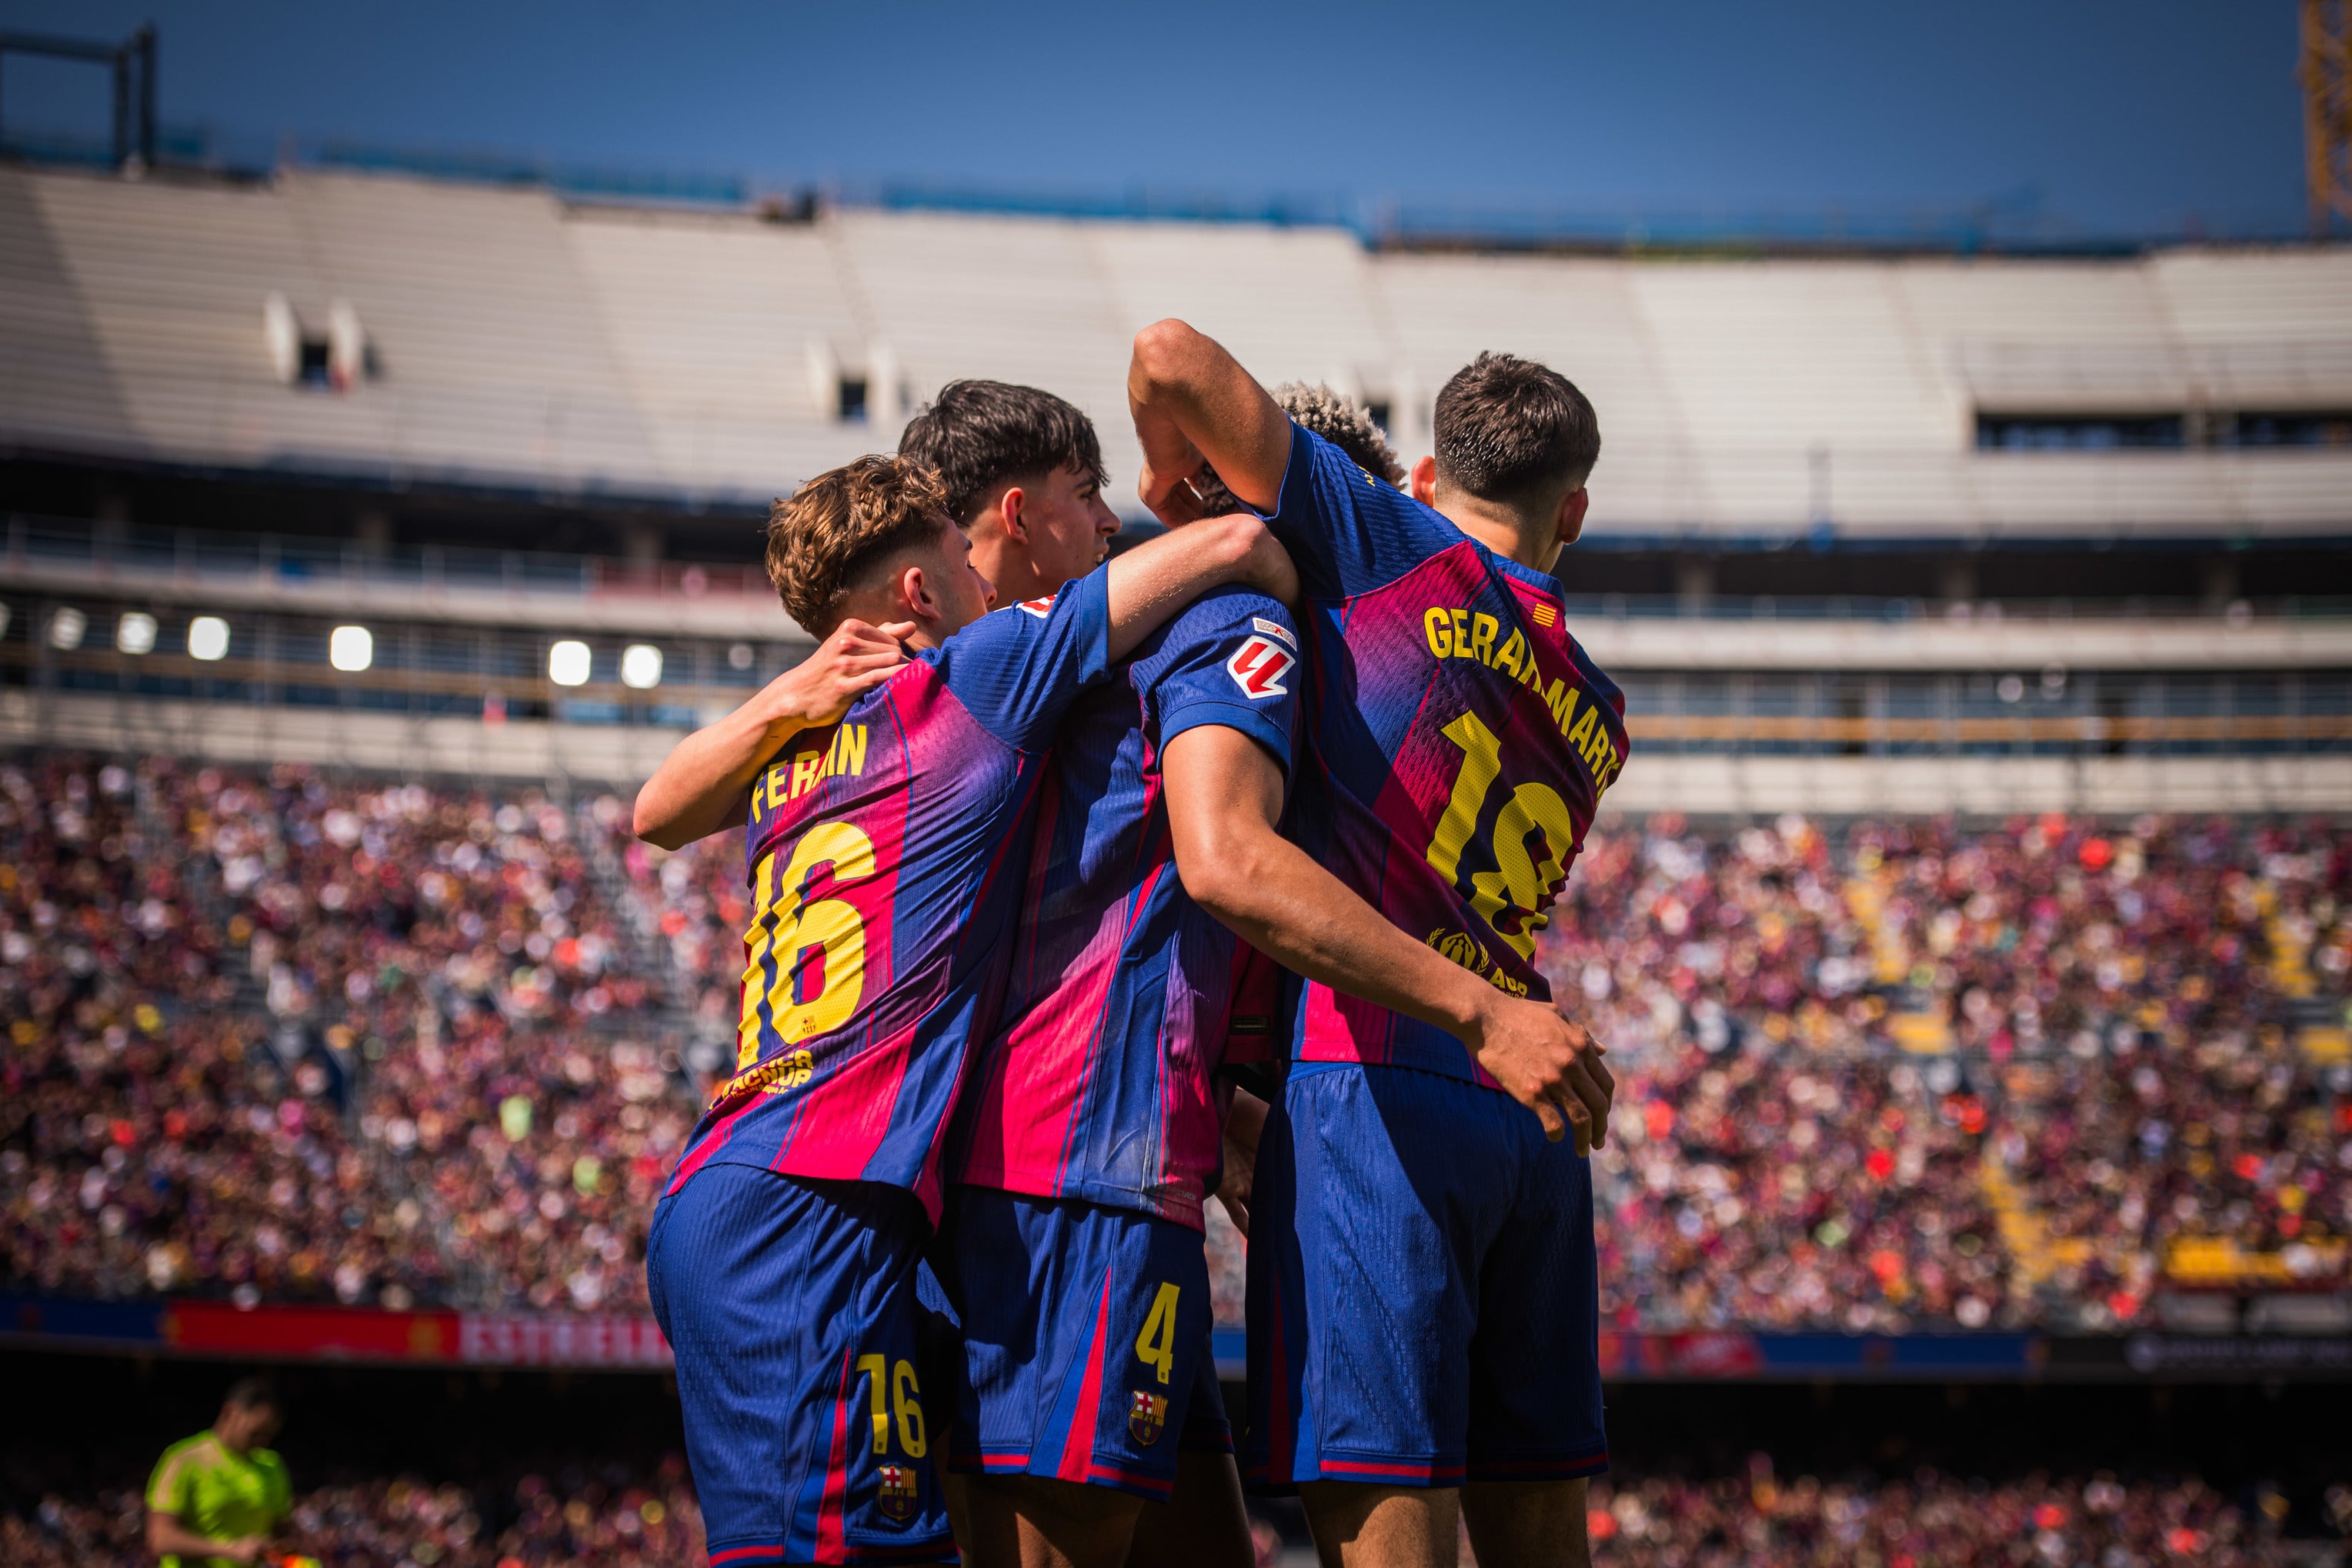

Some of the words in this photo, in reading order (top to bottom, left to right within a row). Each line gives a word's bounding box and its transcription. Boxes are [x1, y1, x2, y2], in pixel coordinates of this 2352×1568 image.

[1426, 709, 1573, 961] 18
[737, 820, 876, 1072] 16
[855, 1353, 927, 1459] 16
[1135, 1282, 1181, 1385] 4
